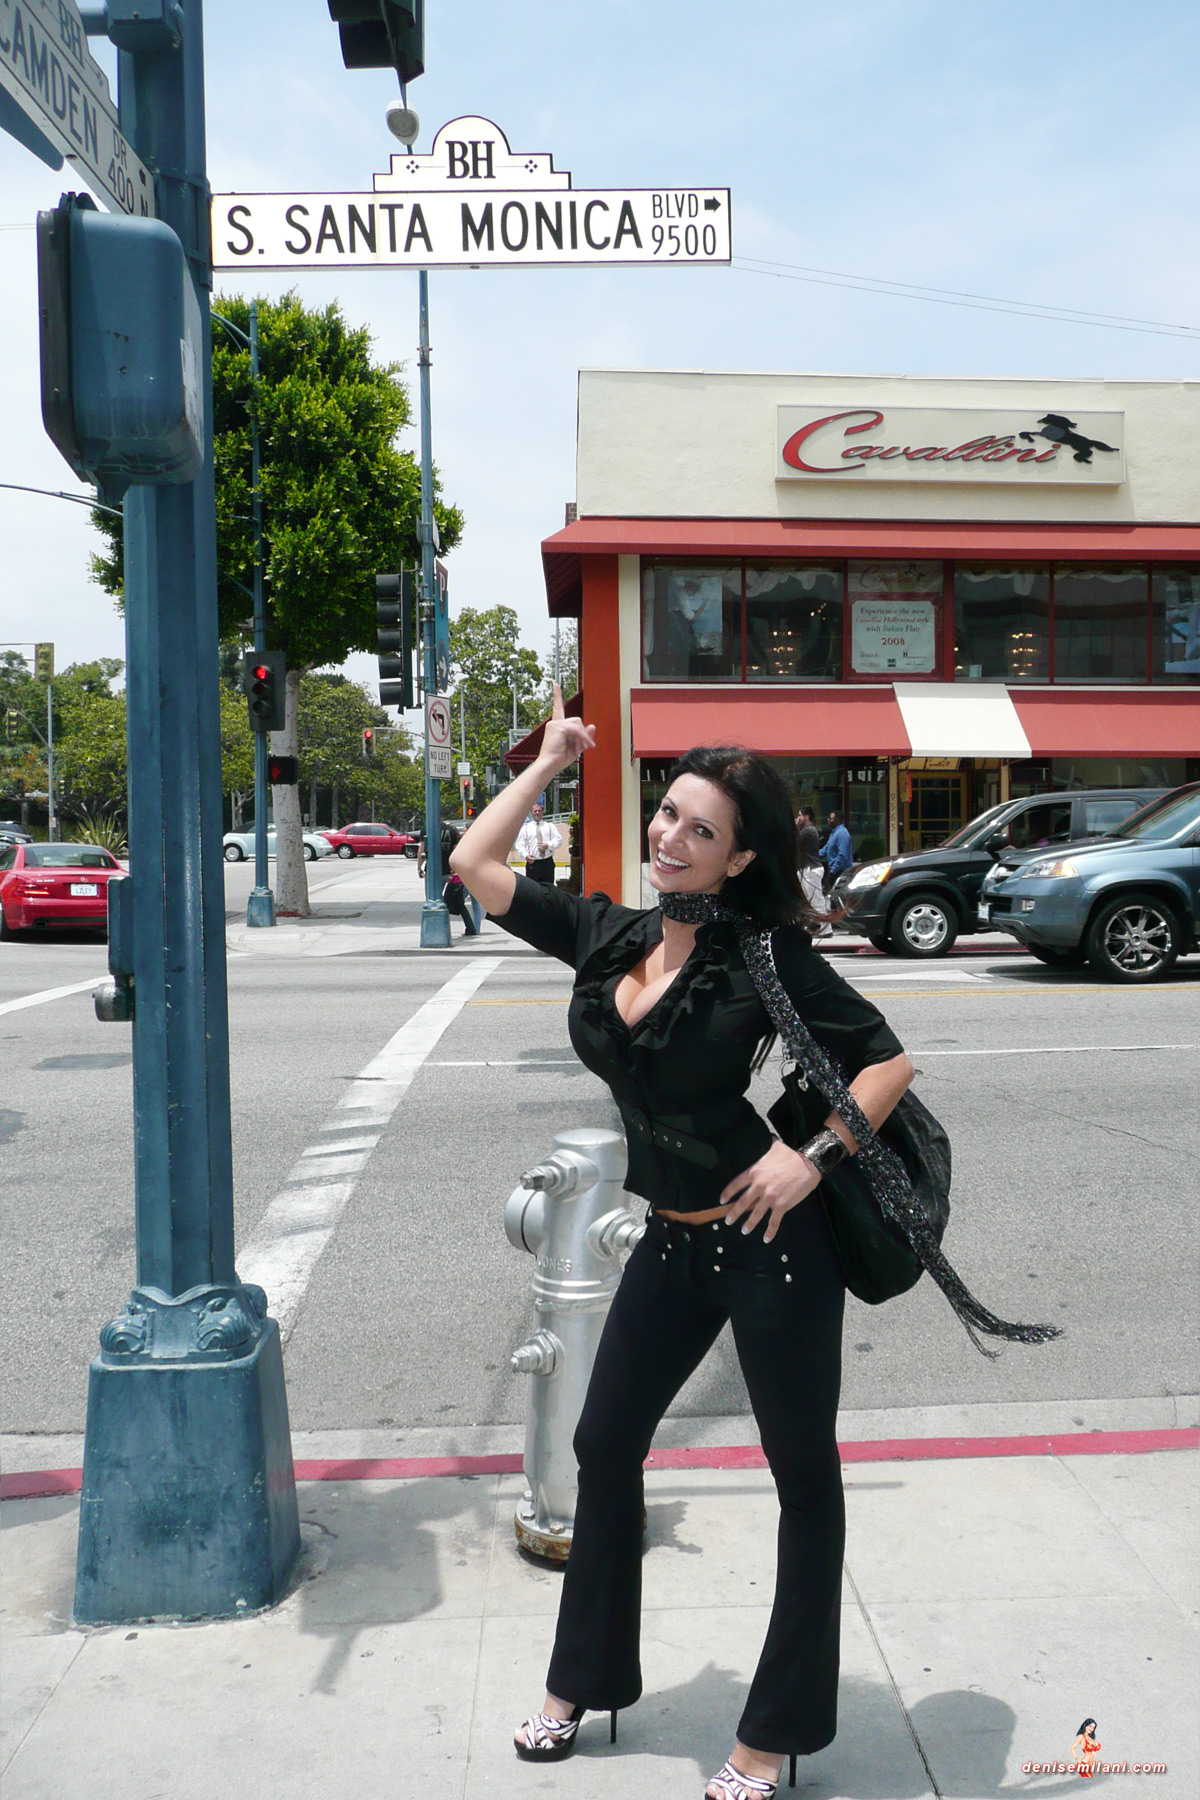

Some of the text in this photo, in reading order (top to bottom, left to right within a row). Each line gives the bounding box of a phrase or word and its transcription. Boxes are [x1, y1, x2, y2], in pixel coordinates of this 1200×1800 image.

[113, 128, 128, 170] DR
[446, 140, 496, 179] BH
[108, 157, 148, 218] 400 N
[227, 194, 699, 255] S. SANTA MONICA BLVD
[652, 224, 717, 257] 9500
[783, 410, 1062, 472] Cavallini
[860, 607, 898, 616] Experience
[881, 637, 905, 646] 2008
[430, 751, 450, 761] NO LEFT
